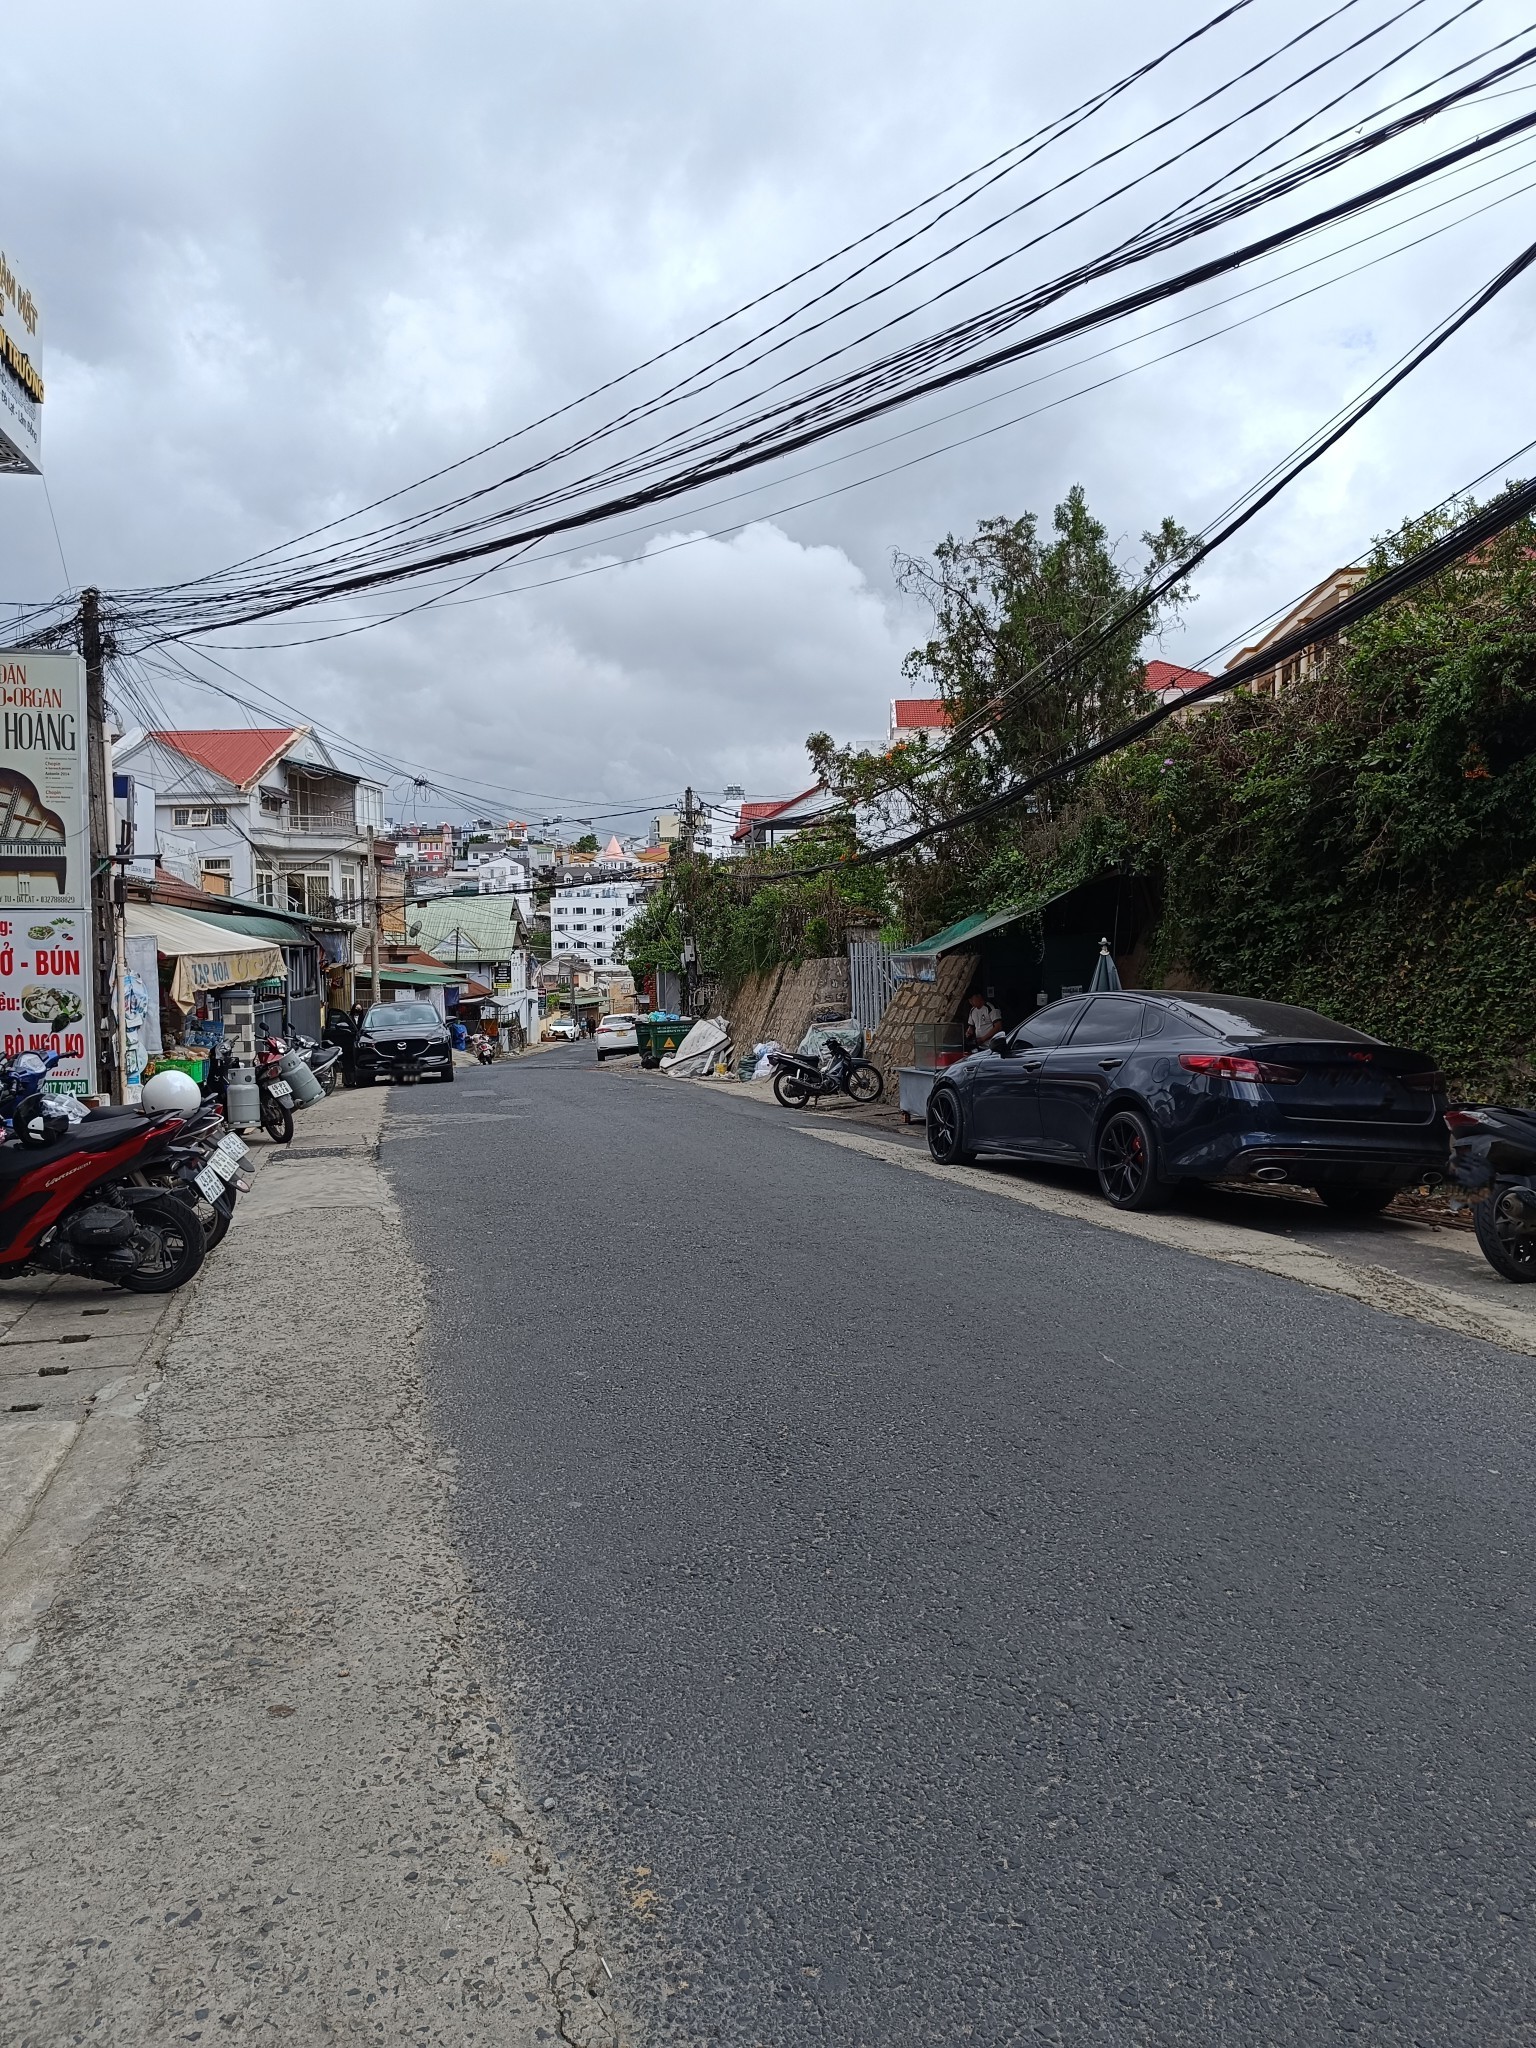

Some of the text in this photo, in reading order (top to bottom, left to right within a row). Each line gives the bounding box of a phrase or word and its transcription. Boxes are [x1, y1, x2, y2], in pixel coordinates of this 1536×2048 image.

[7, 336, 44, 401] TRƯỜNG
[35, 944, 80, 976] BÚN
[211, 956, 230, 982] HÓA
[41, 1082, 58, 1094] 917
[73, 1081, 86, 1094] 750
